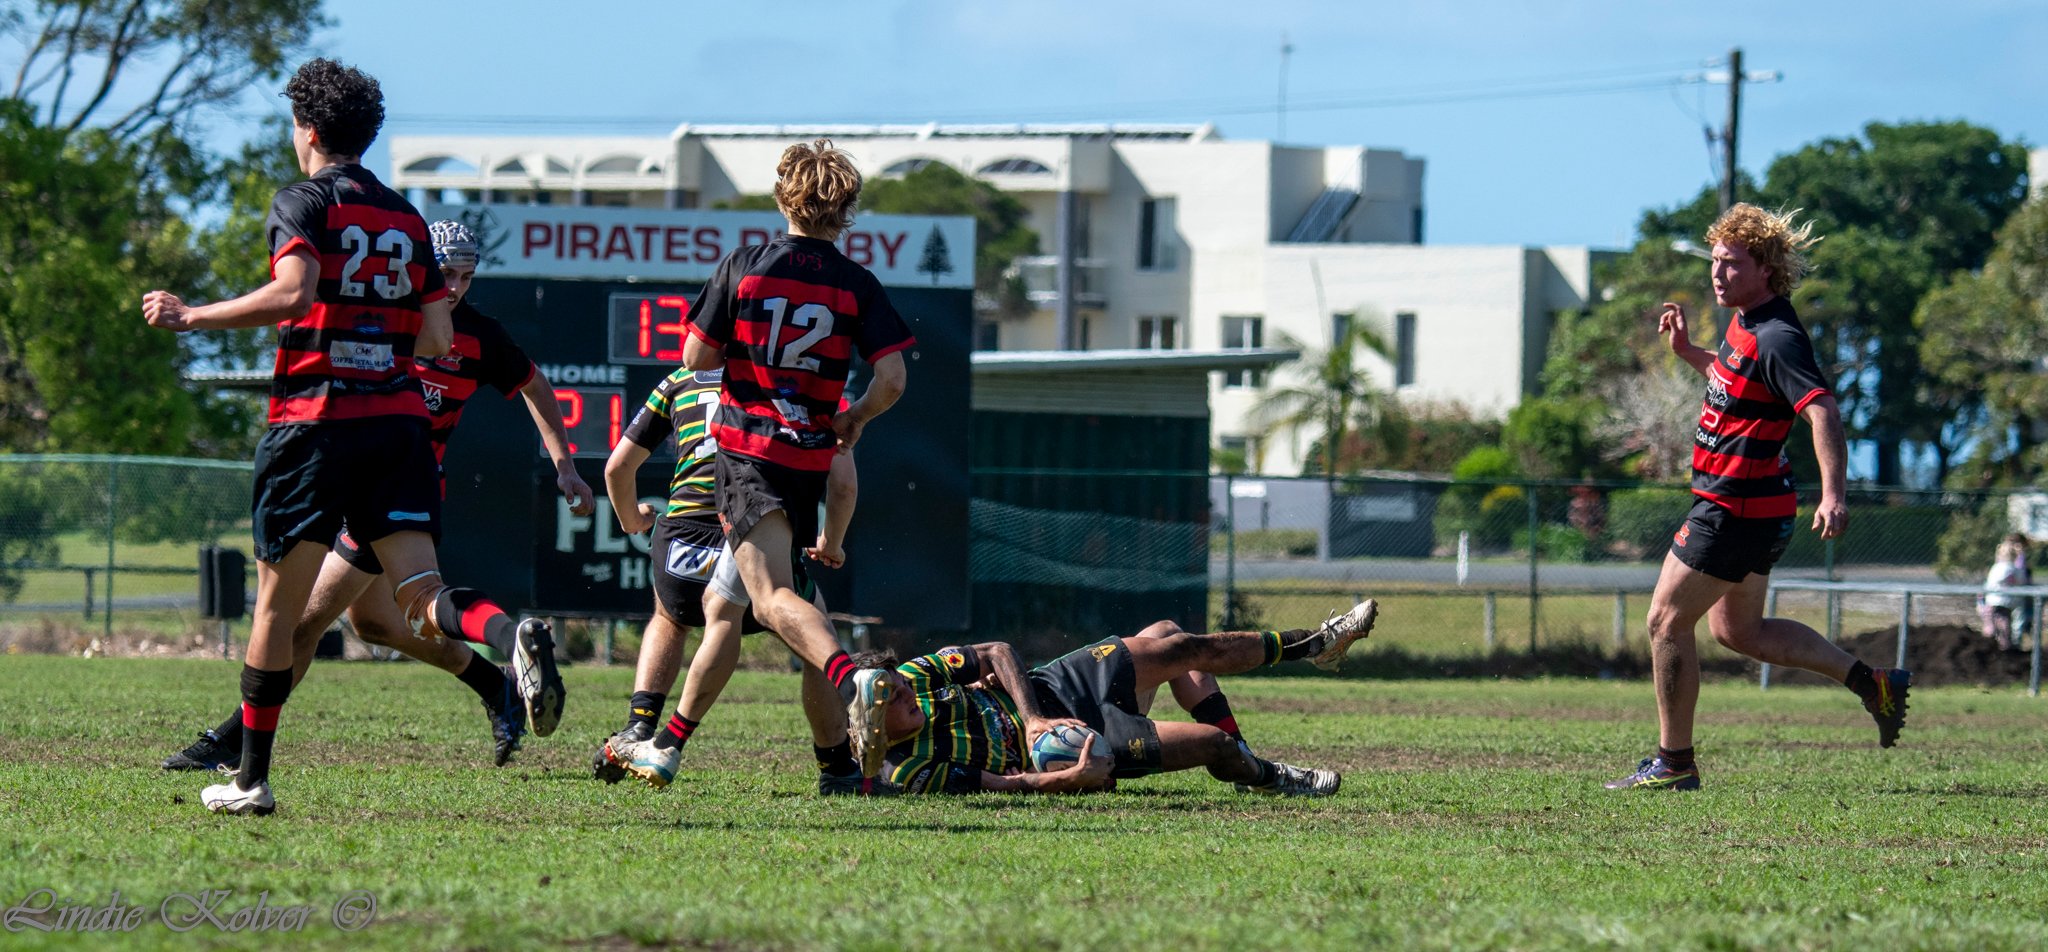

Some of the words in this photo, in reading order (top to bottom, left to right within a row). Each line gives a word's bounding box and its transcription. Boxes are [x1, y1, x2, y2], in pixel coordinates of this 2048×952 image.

[339, 224, 414, 300] 23
[523, 222, 721, 263] PIRATES
[739, 229, 907, 268] RBY
[638, 296, 690, 361] 13
[763, 296, 835, 374] 12
[541, 363, 626, 384] HOME
[1696, 427, 1717, 448] Coast
